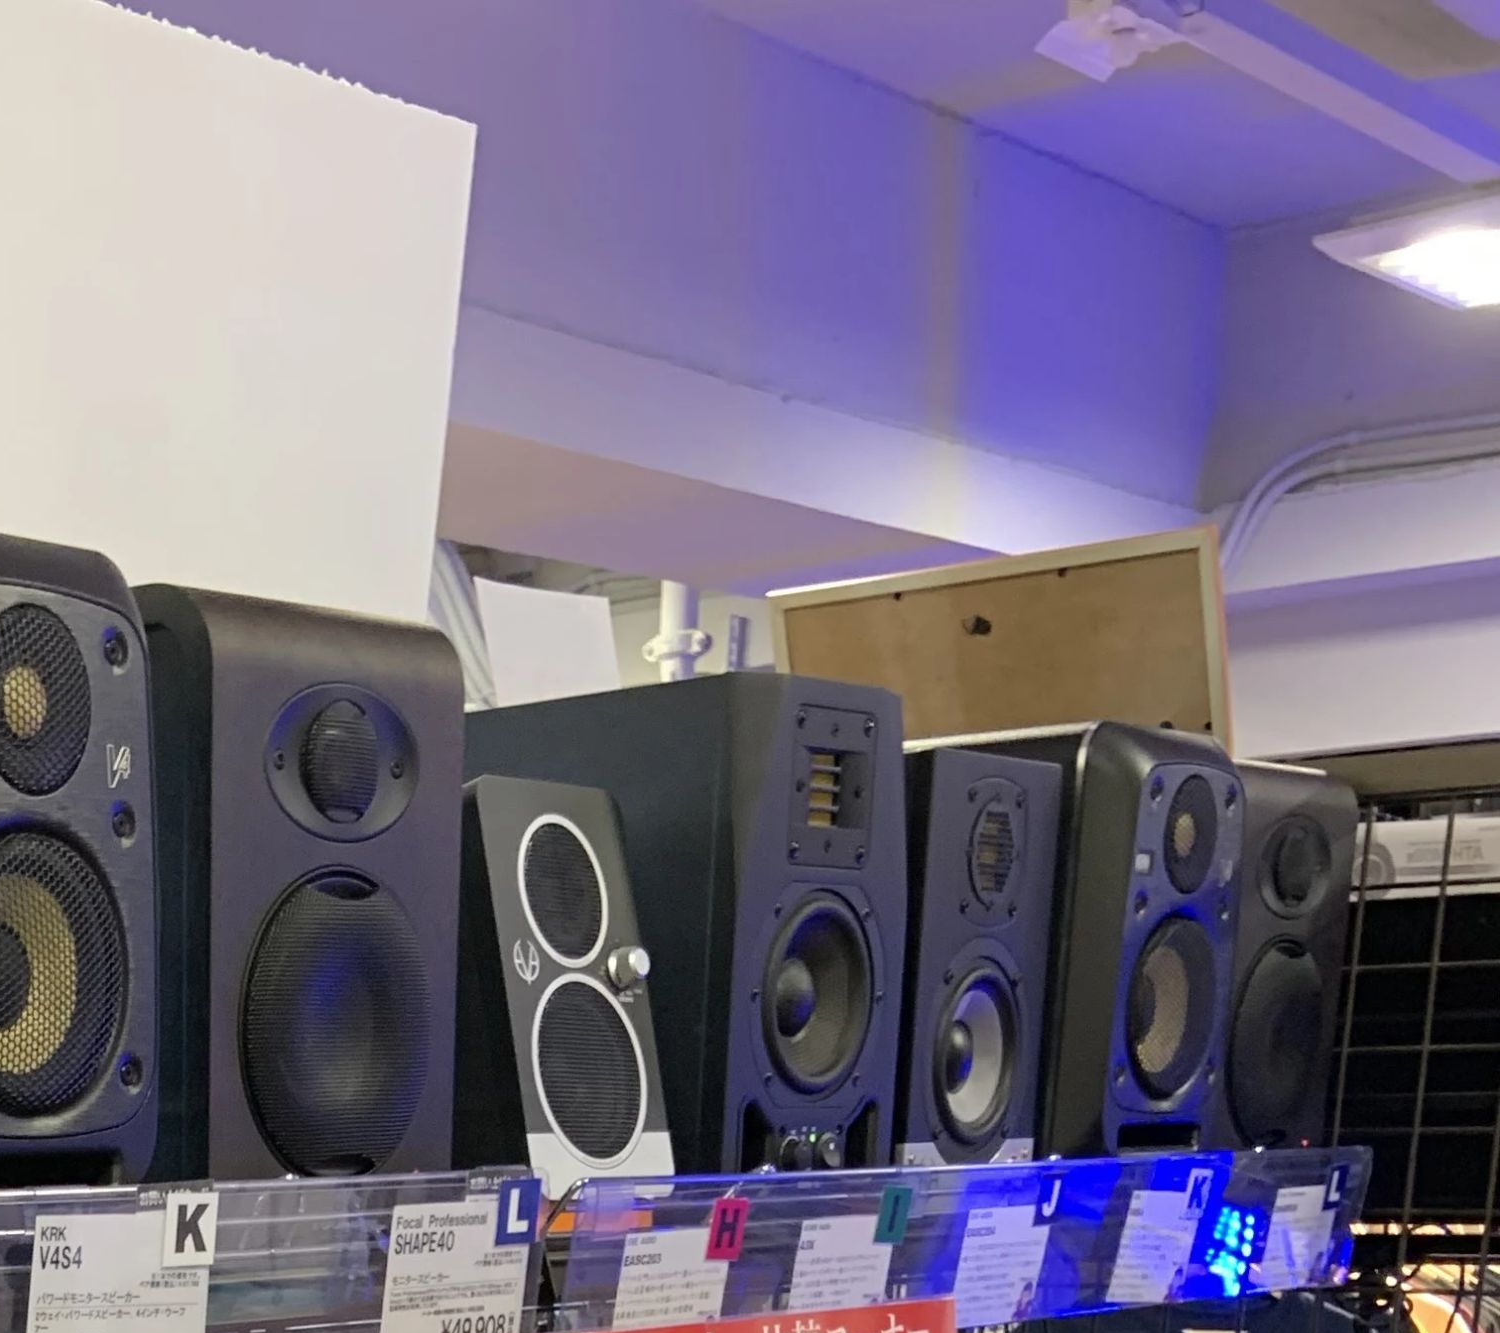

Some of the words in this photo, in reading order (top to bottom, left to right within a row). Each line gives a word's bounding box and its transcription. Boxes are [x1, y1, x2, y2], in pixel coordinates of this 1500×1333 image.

[1042, 1180, 1061, 1217] J
[1329, 1170, 1341, 1201] L
[396, 1215, 424, 1230] Focal
[428, 1212, 488, 1228] Professional
[506, 1188, 529, 1234] L
[40, 1226, 67, 1242] KRK
[175, 1203, 210, 1254] K
[394, 1231, 455, 1255] SHAPE40
[715, 1208, 741, 1249] H
[39, 1246, 83, 1270] V4S4
